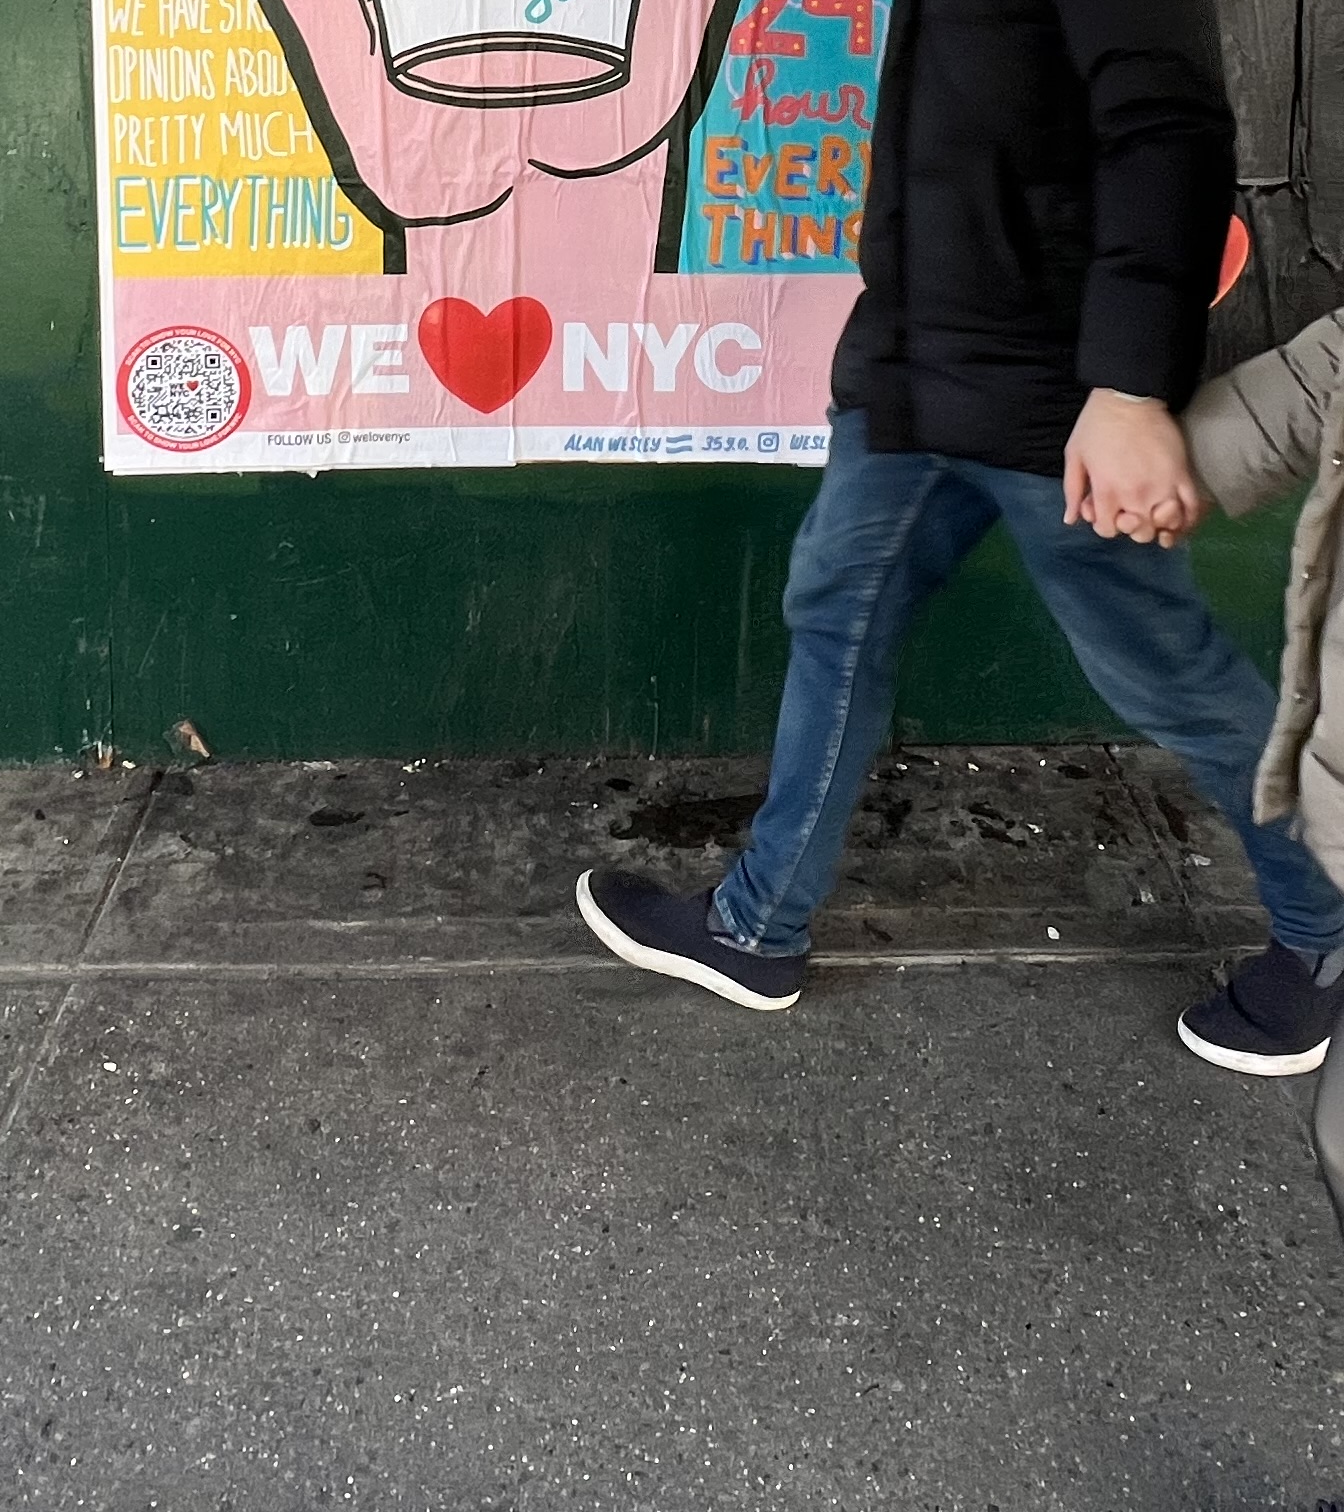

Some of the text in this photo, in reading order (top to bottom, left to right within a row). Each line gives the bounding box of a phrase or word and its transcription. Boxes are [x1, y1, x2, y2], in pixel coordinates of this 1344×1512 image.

[109, 43, 299, 105] OPINIONS ABOU
[114, 111, 314, 168] PRETTY MUCH
[114, 173, 354, 254] EVERYTHING
[249, 321, 763, 396] WE NYC
[267, 431, 411, 446] FOLLOW US welovenyc
[564, 433, 604, 452] ALAN
